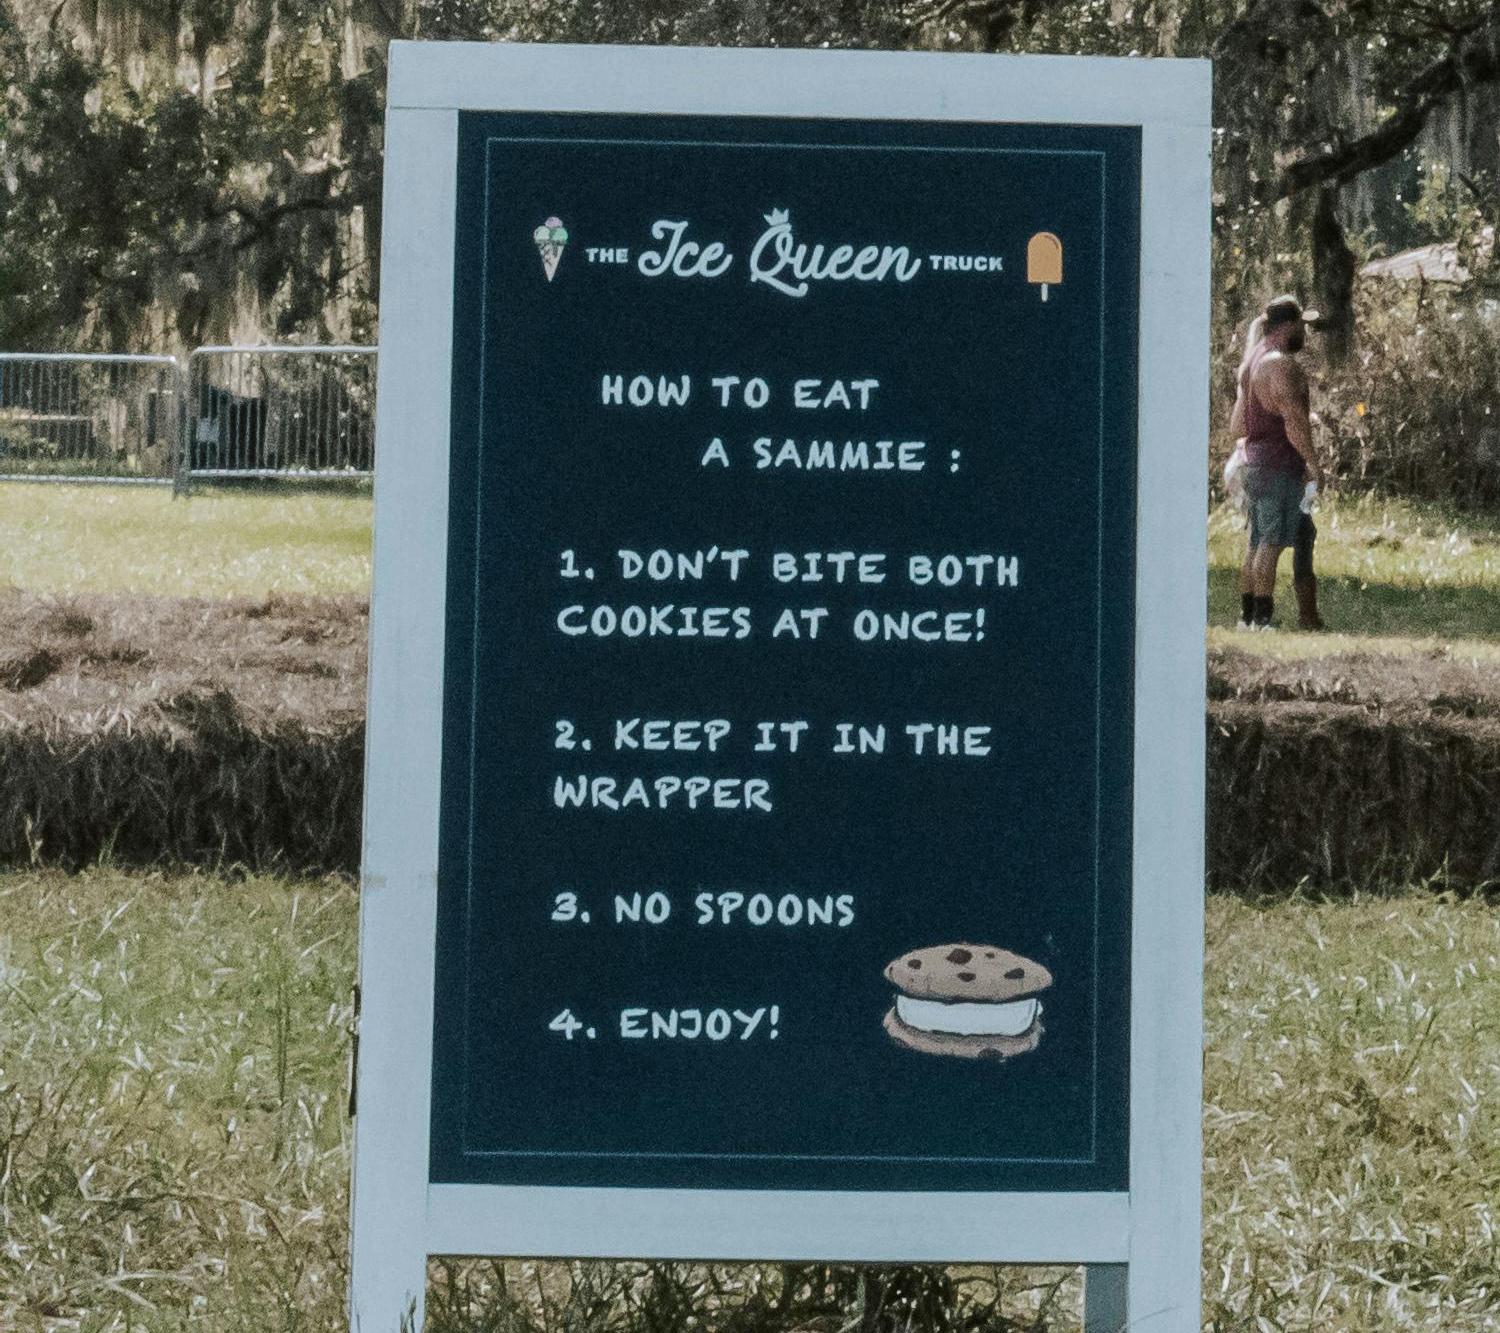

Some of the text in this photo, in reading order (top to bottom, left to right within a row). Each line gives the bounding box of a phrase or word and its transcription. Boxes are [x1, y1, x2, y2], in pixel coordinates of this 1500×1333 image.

[586, 220, 1004, 298] THE Ice Queen TRUCK
[600, 375, 880, 411] HOW TO EAT
[700, 437, 926, 472] A SAMMIE
[560, 544, 1019, 588] 1. DON'T BITE BOTH
[556, 604, 986, 643] COOKIES AT ONCE!
[553, 718, 992, 757] 2. KEEP IT IN THE
[553, 776, 773, 813] WRAPPER
[551, 892, 855, 927] 3. NO SPOONS
[548, 1004, 780, 1041] 4. ENJOY!
